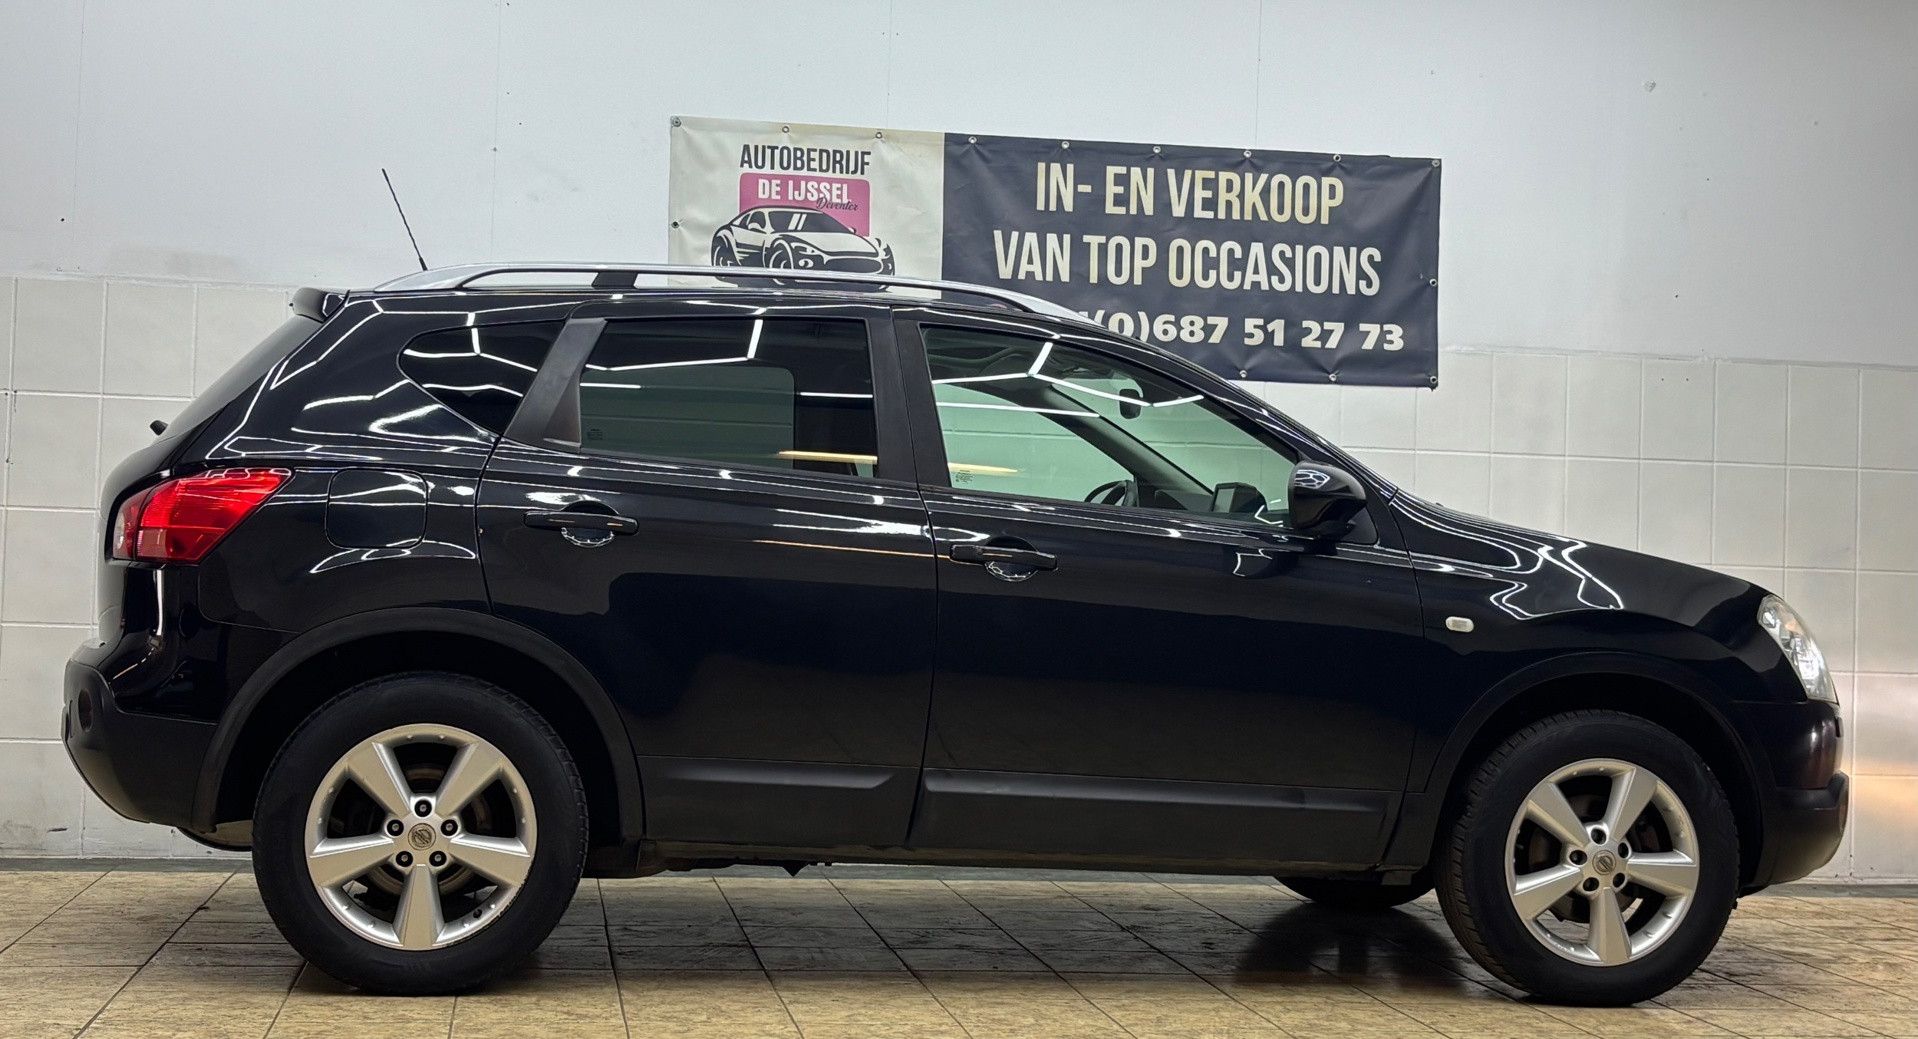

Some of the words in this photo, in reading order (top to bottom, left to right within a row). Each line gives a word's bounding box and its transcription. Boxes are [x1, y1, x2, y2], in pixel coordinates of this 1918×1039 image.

[740, 144, 872, 176] AUTOBEDRIJF
[758, 178, 781, 200] DE
[788, 180, 852, 204] IJSSEL
[1035, 161, 1092, 213] IN-
[1105, 165, 1155, 216] EN
[1167, 168, 1345, 225] VERKOOP
[993, 229, 1071, 283] VAN
[1082, 234, 1158, 286] TOP
[1168, 238, 1382, 297] OCCASIONS
[1243, 317, 1286, 347] 51
[1301, 320, 1345, 349] 27
[1358, 322, 1405, 351] 73
